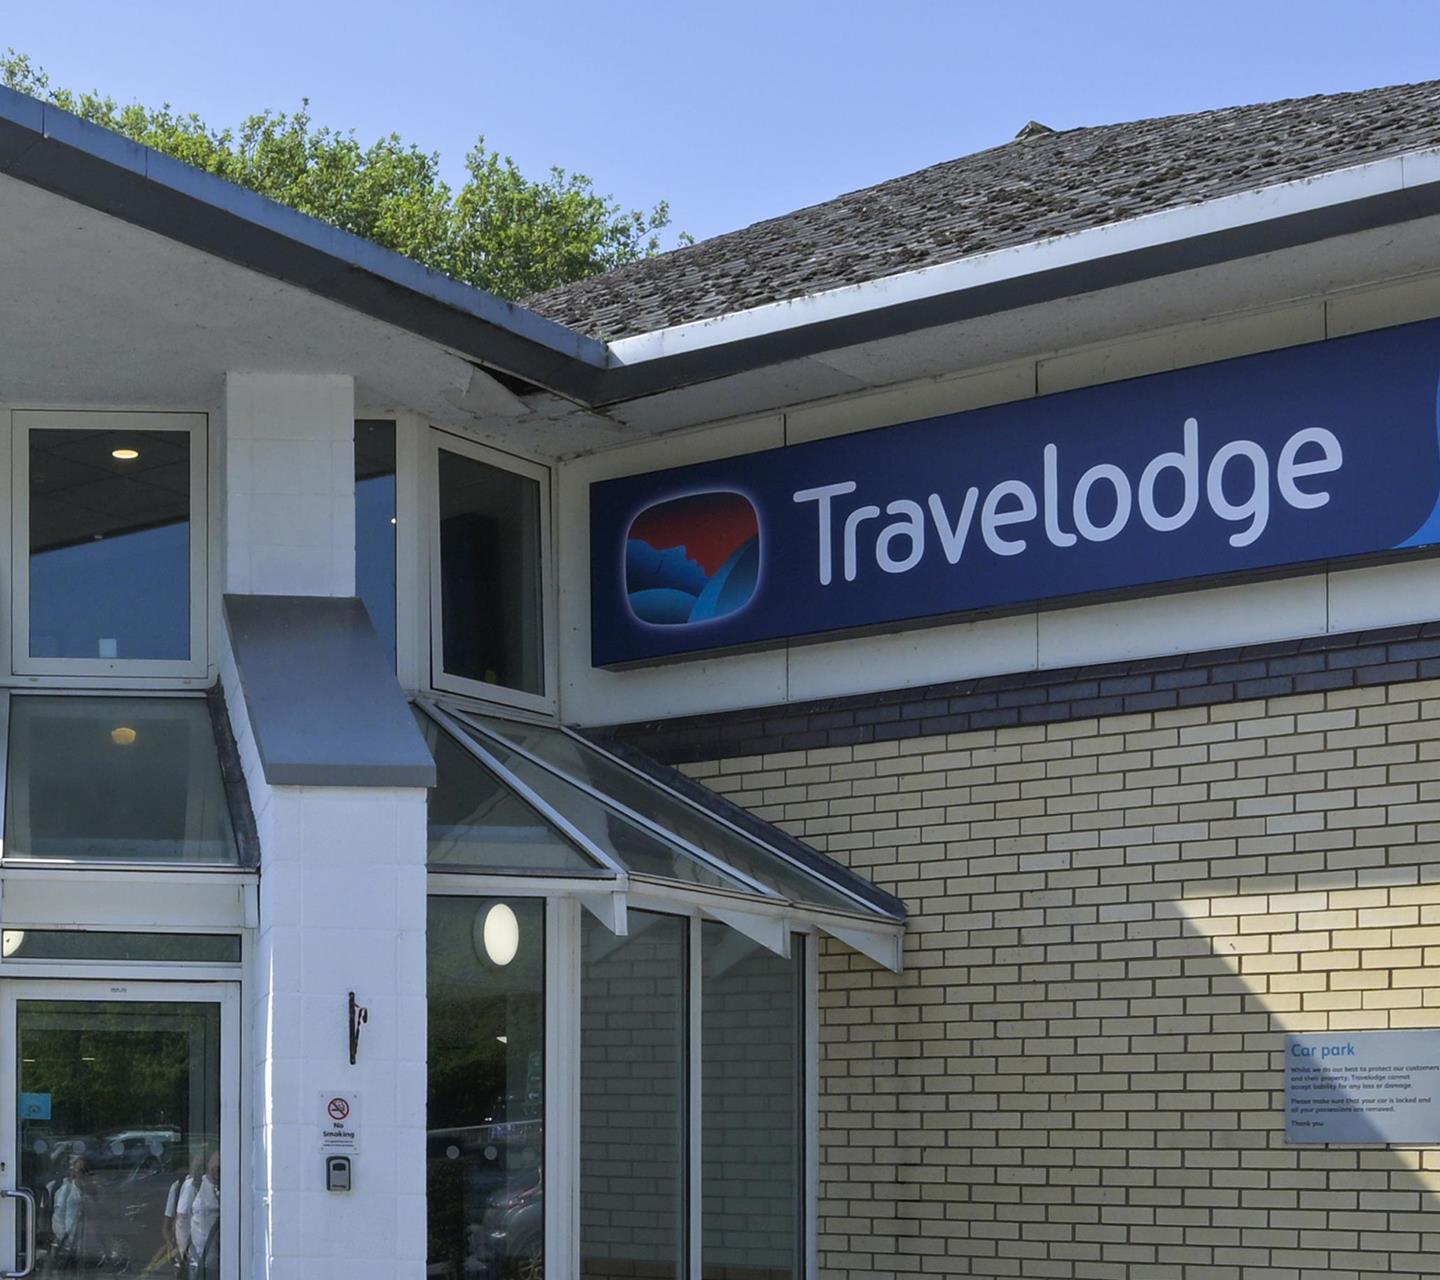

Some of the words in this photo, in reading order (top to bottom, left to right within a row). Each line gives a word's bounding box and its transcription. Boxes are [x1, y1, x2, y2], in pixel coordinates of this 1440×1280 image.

[793, 417, 1343, 585] Travelodge
[1291, 1043, 1317, 1057] Car
[1321, 1042, 1355, 1060] park
[322, 1130, 355, 1139] Smoking
